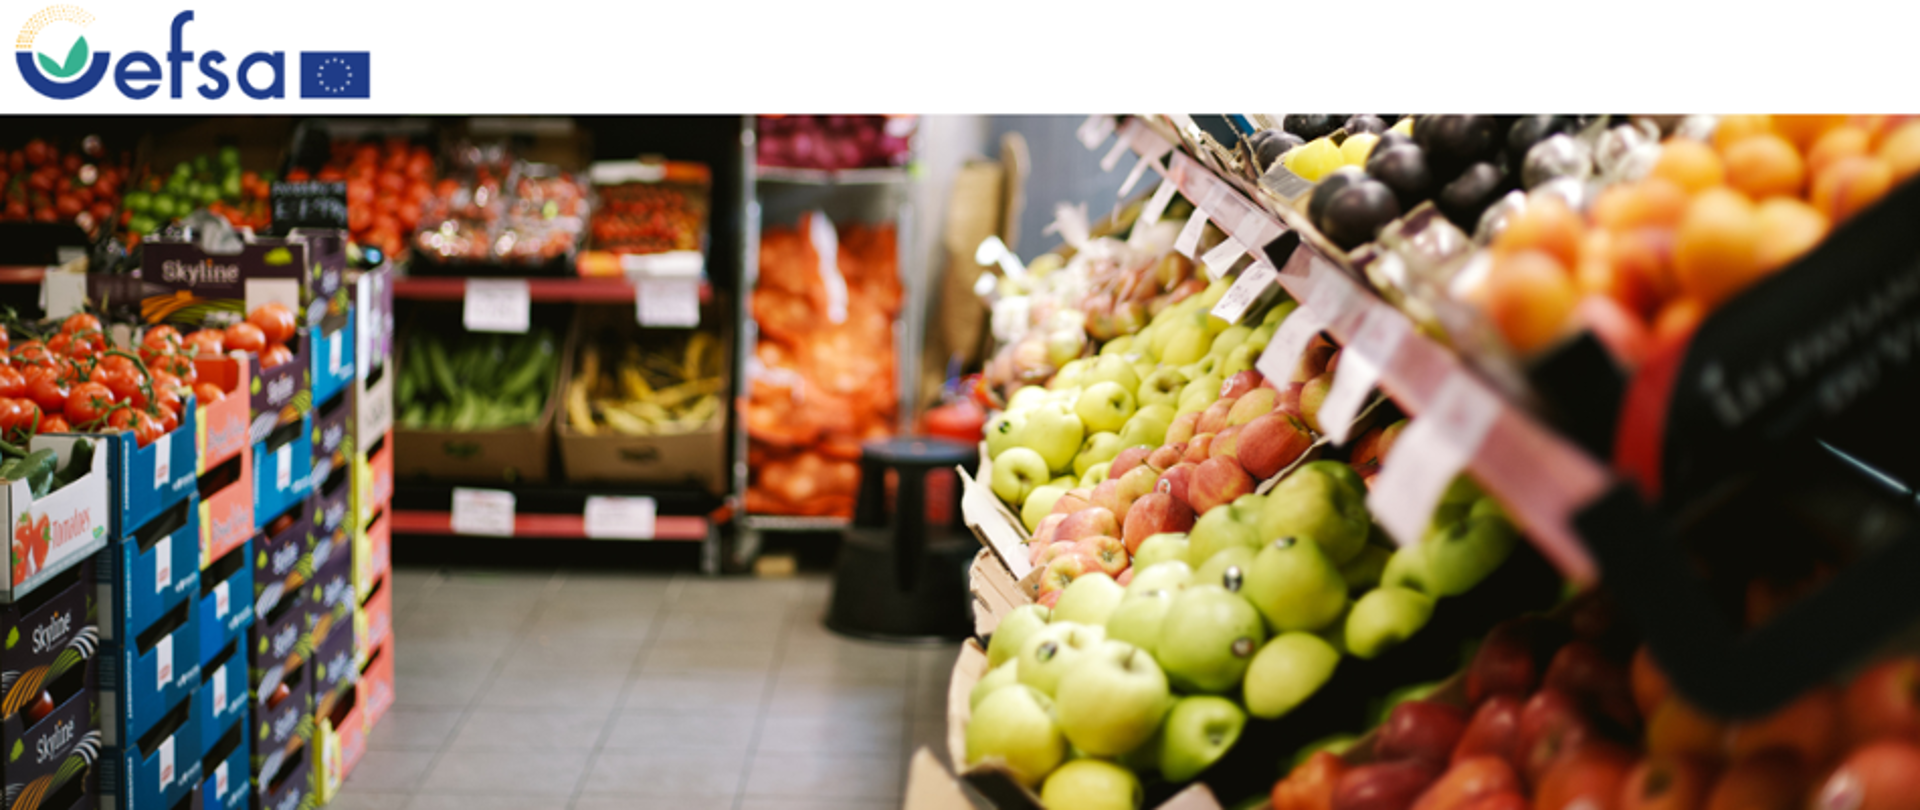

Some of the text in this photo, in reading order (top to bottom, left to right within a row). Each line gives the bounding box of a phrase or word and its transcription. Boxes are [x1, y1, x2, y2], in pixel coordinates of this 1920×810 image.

[162, 258, 239, 287] Skyline
[52, 507, 91, 549] Tomatoes
[32, 611, 71, 654] Skyline
[36, 720, 74, 764] Skyline
